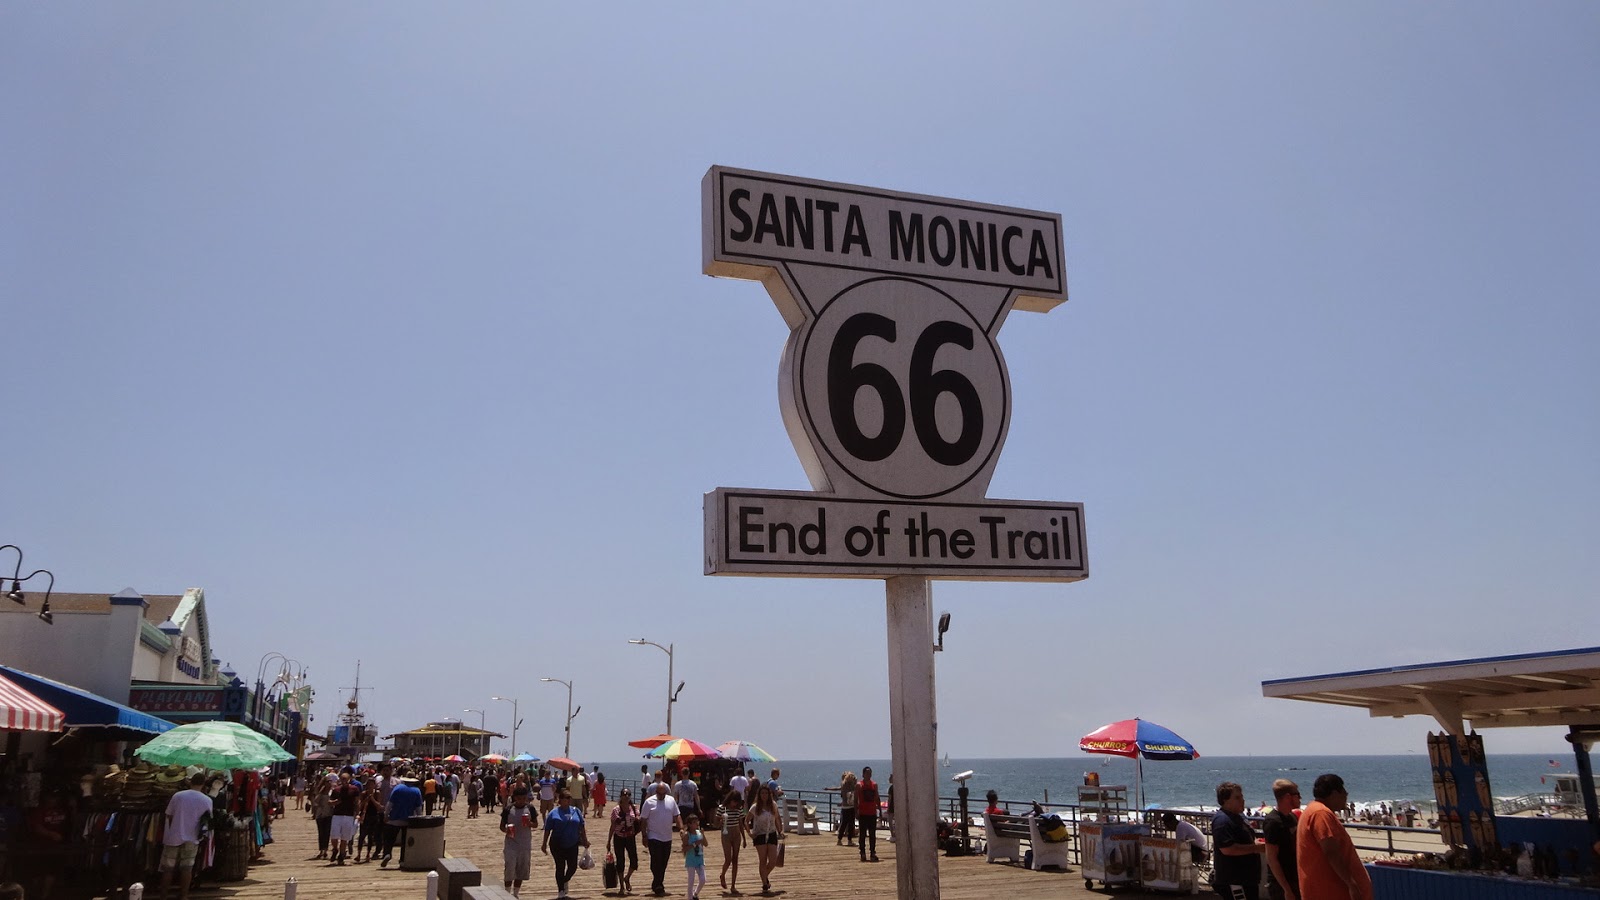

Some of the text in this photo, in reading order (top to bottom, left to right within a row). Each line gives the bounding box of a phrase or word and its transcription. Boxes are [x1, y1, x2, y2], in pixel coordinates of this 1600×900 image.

[729, 188, 1054, 279] SANTA MONICA
[827, 312, 984, 466] 66
[739, 506, 1071, 560] End of the Trail
[140, 691, 215, 703] PLAYLAND
[1088, 741, 1127, 750] CHURROS
[1145, 744, 1187, 752] CHURROS
